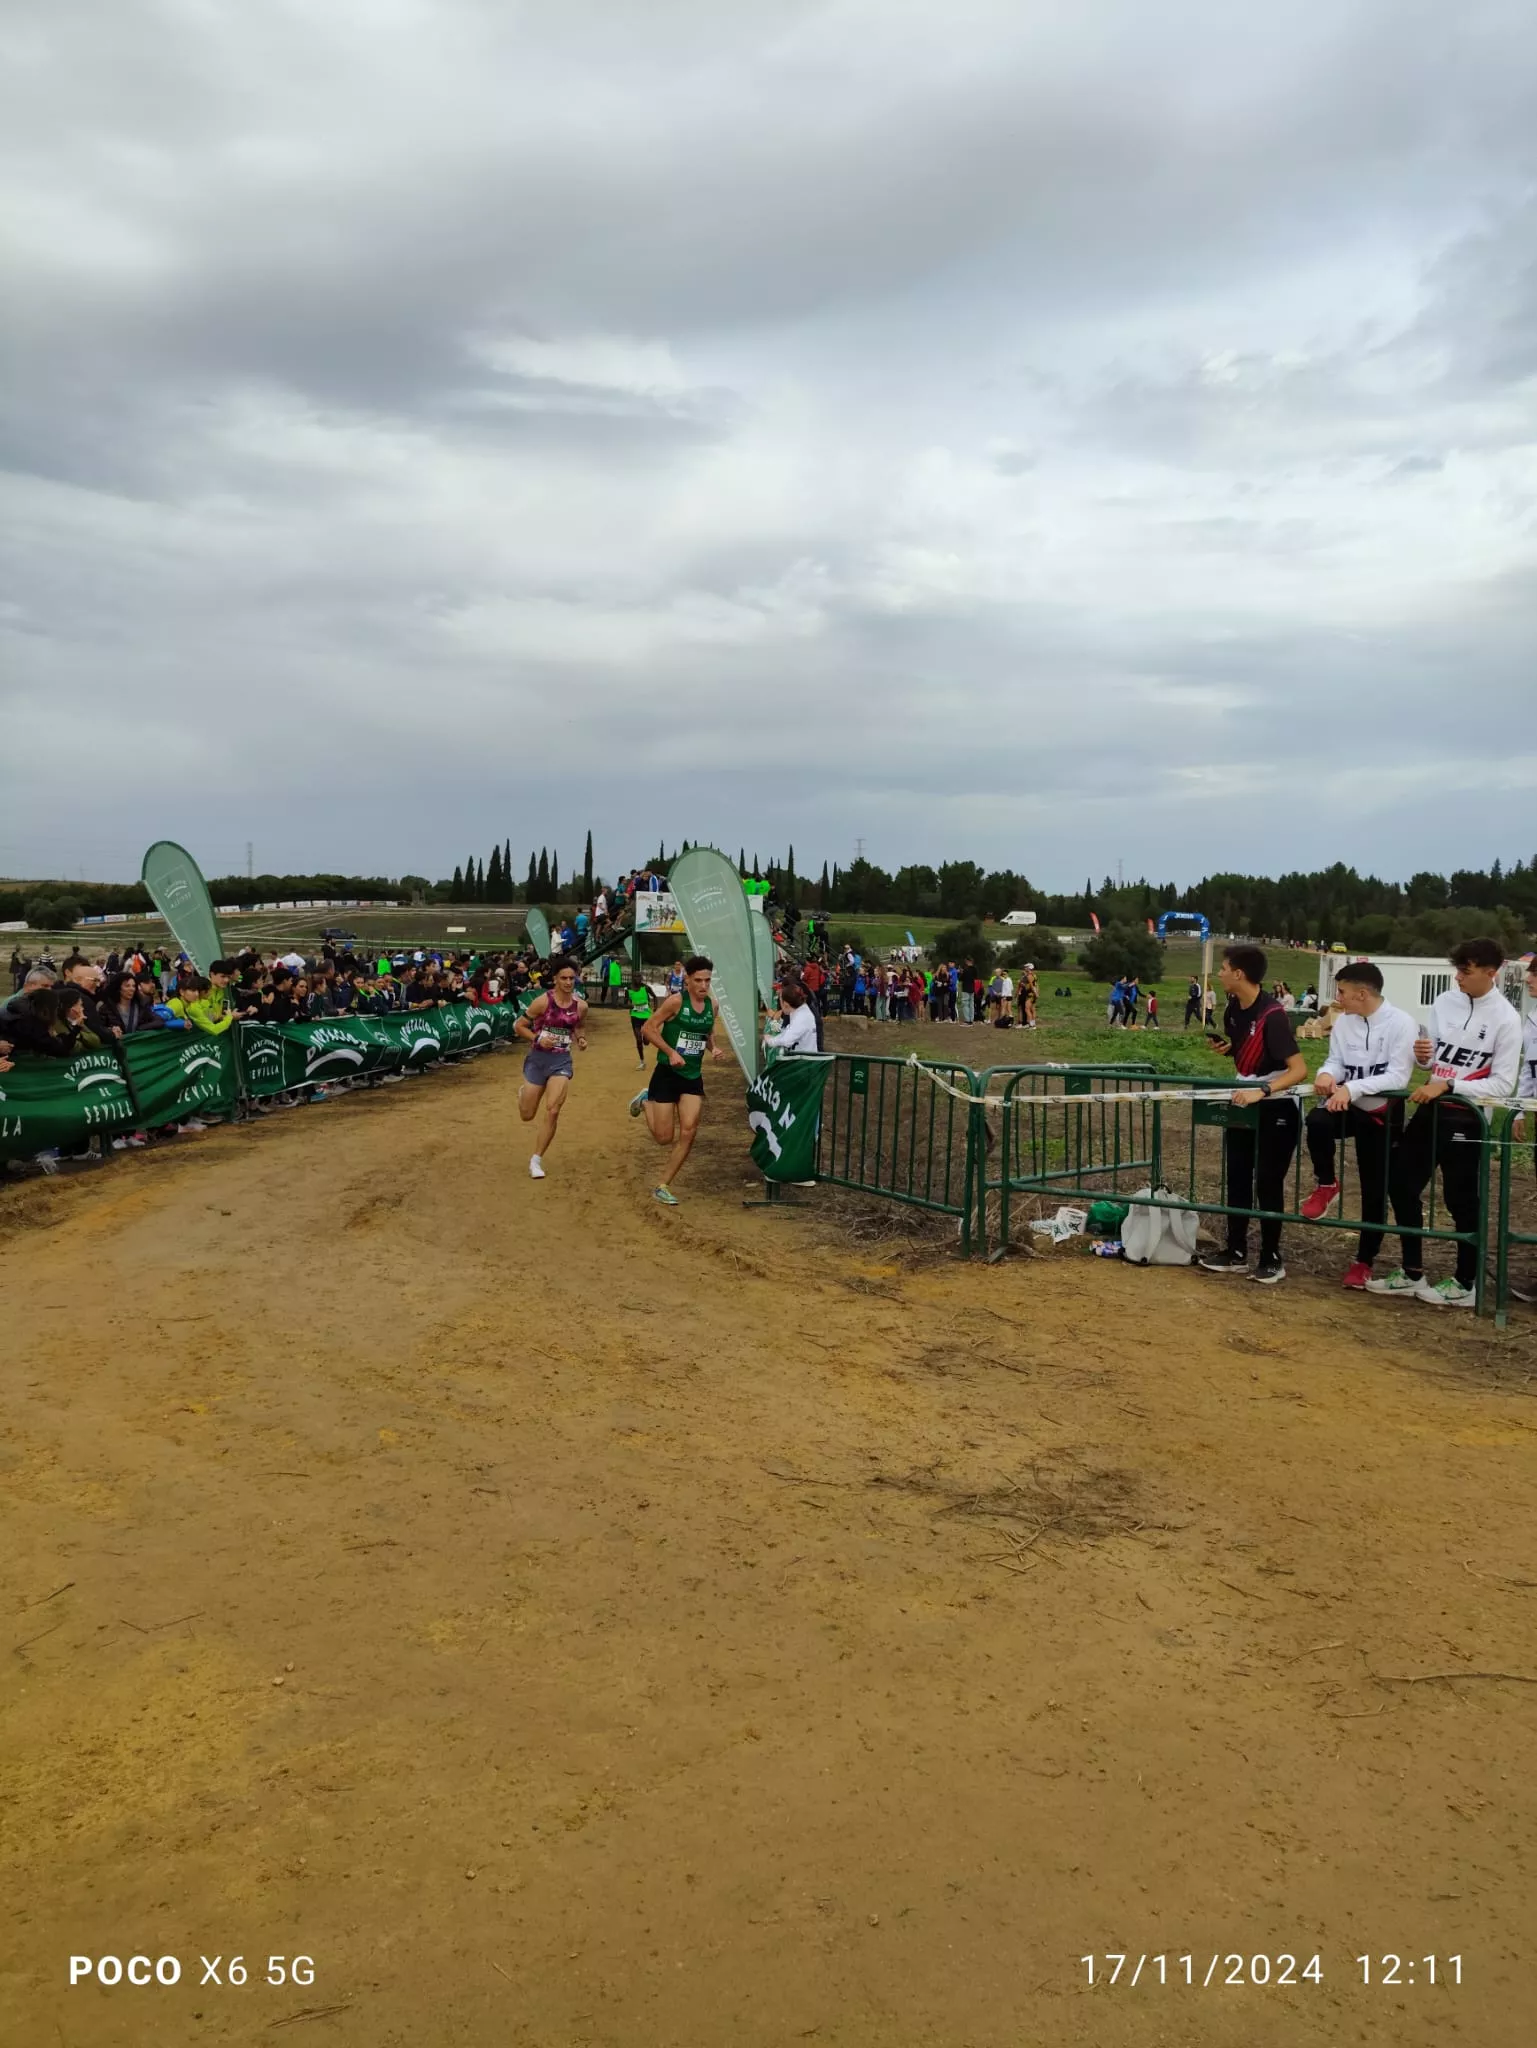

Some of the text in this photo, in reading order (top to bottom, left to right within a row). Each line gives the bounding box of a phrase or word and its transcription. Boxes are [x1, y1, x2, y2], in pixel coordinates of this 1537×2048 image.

[64, 1055, 122, 1082] DIPUTACIO
[250, 1065, 280, 1080] EVILLA
[83, 1100, 133, 1124] SEVILL
